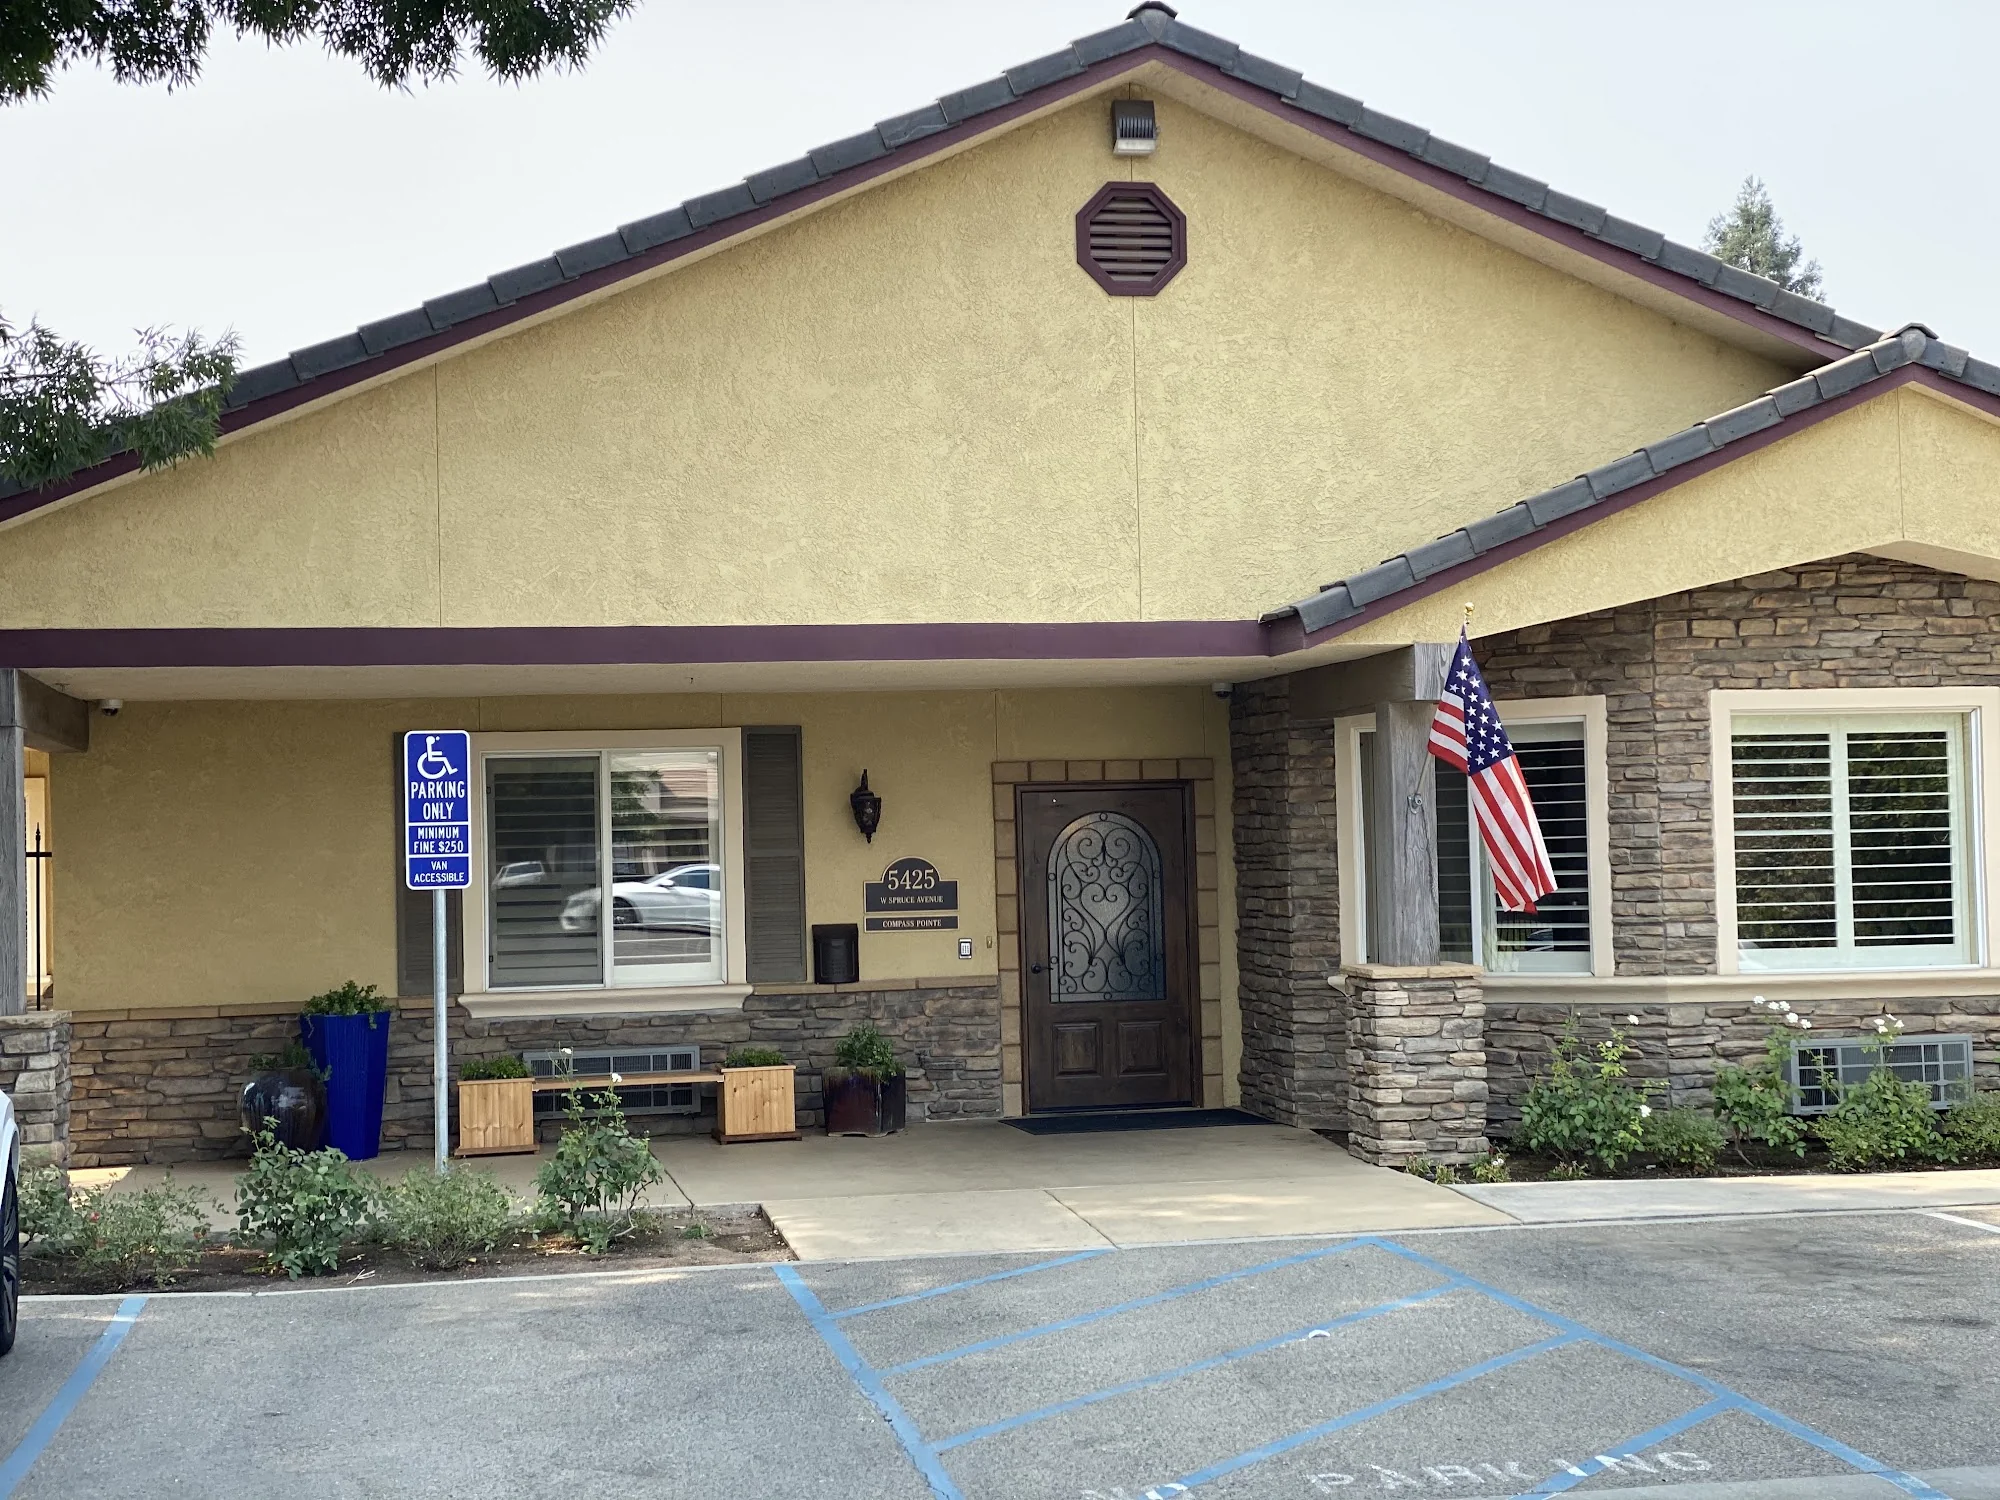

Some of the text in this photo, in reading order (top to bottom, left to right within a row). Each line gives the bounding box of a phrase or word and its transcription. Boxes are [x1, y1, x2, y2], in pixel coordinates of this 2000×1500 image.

[410, 781, 465, 799] PARKING
[422, 802, 454, 820] ONLY
[417, 826, 459, 839] MINIMUM
[413, 840, 464, 853] FINE $250
[431, 861, 448, 870] VAN
[414, 872, 465, 883] ACCESSIBLE
[887, 868, 936, 891] 5425
[880, 895, 944, 905] W SPRUCE AVENUE
[882, 919, 942, 928] COMPASS POINTE
